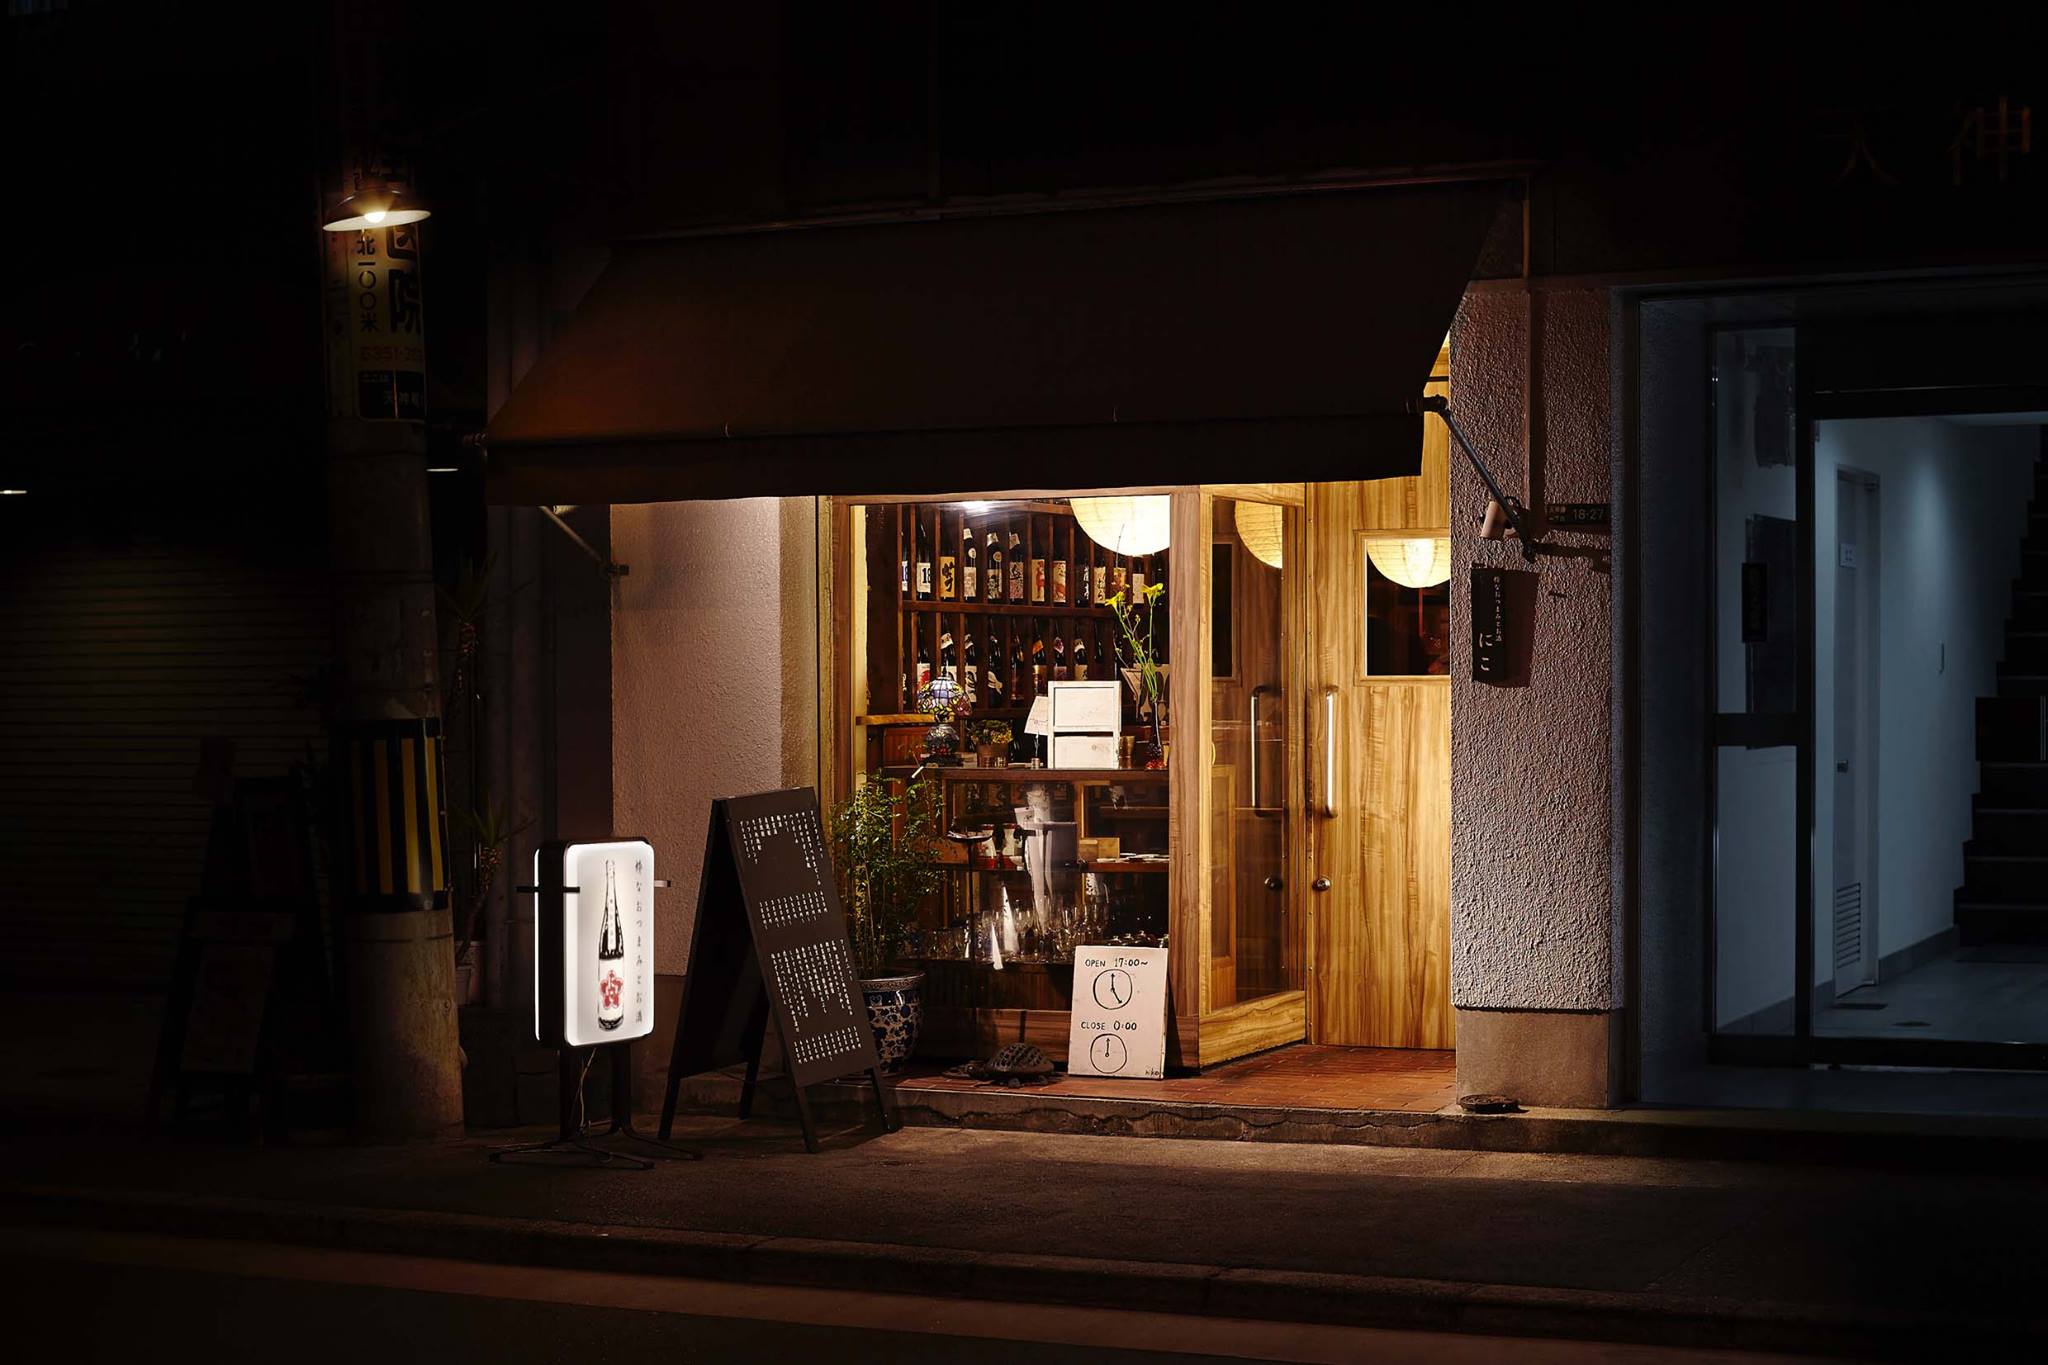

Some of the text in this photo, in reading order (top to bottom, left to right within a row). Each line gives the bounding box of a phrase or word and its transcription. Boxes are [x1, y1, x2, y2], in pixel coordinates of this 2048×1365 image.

[1478, 632, 1493, 672] にこ
[1084, 959, 1106, 968] OPEN
[1080, 1020, 1138, 1031] CLOSE 0:00
